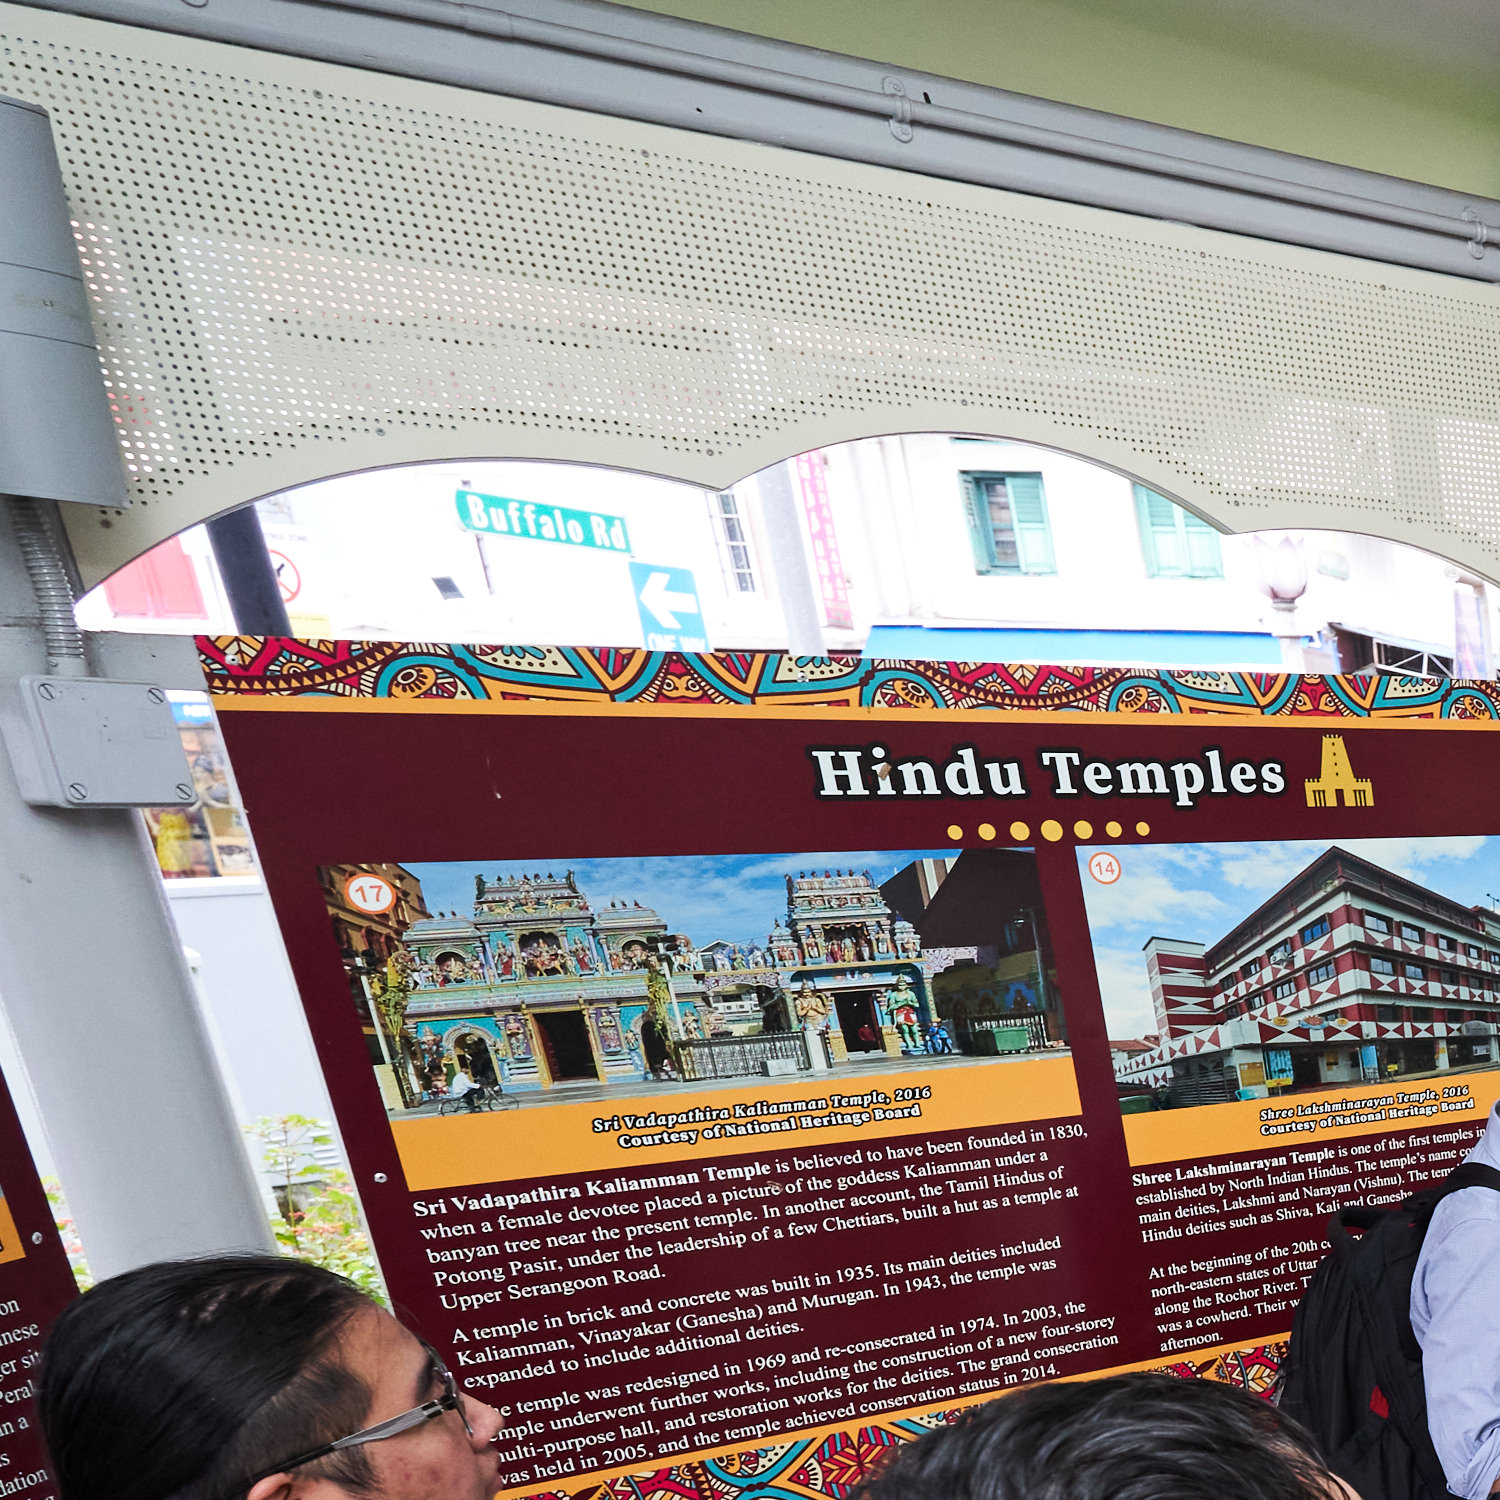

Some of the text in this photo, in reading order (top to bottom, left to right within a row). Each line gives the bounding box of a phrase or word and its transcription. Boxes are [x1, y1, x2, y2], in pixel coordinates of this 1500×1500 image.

[466, 494, 627, 550] Buffalo Rd
[811, 746, 1285, 806] Hindu Temples
[1095, 860, 1116, 876] 14
[355, 885, 383, 903] 17
[593, 1086, 931, 1132] Sri Vadapathira Kaliamman Temple, 2016
[619, 1104, 921, 1148] Courtesy of National Heritage Board
[1260, 1086, 1469, 1123] Shree Lakshminarayan Temple, 2016
[1260, 1098, 1475, 1135] Courtesy of National Heritage Board
[412, 1123, 1088, 1217] Sri Vadapathira Kaliamman Temple is believed to have been founded in 1830,
[1131, 1172, 1173, 1187] Shree
[1174, 1156, 1288, 1181] Lakshminarayan
[1288, 1147, 1335, 1164] Temple
[1337, 1145, 1349, 1158] is
[1350, 1144, 1372, 1156] one
[1373, 1137, 1406, 1153] of
[1408, 1134, 1431, 1148] the
[1432, 1128, 1474, 1144] first
[1475, 1127, 1488, 1139] in
[419, 1150, 1049, 1240] when a female devotee placed a picture of the goddess Kaliamman under a
